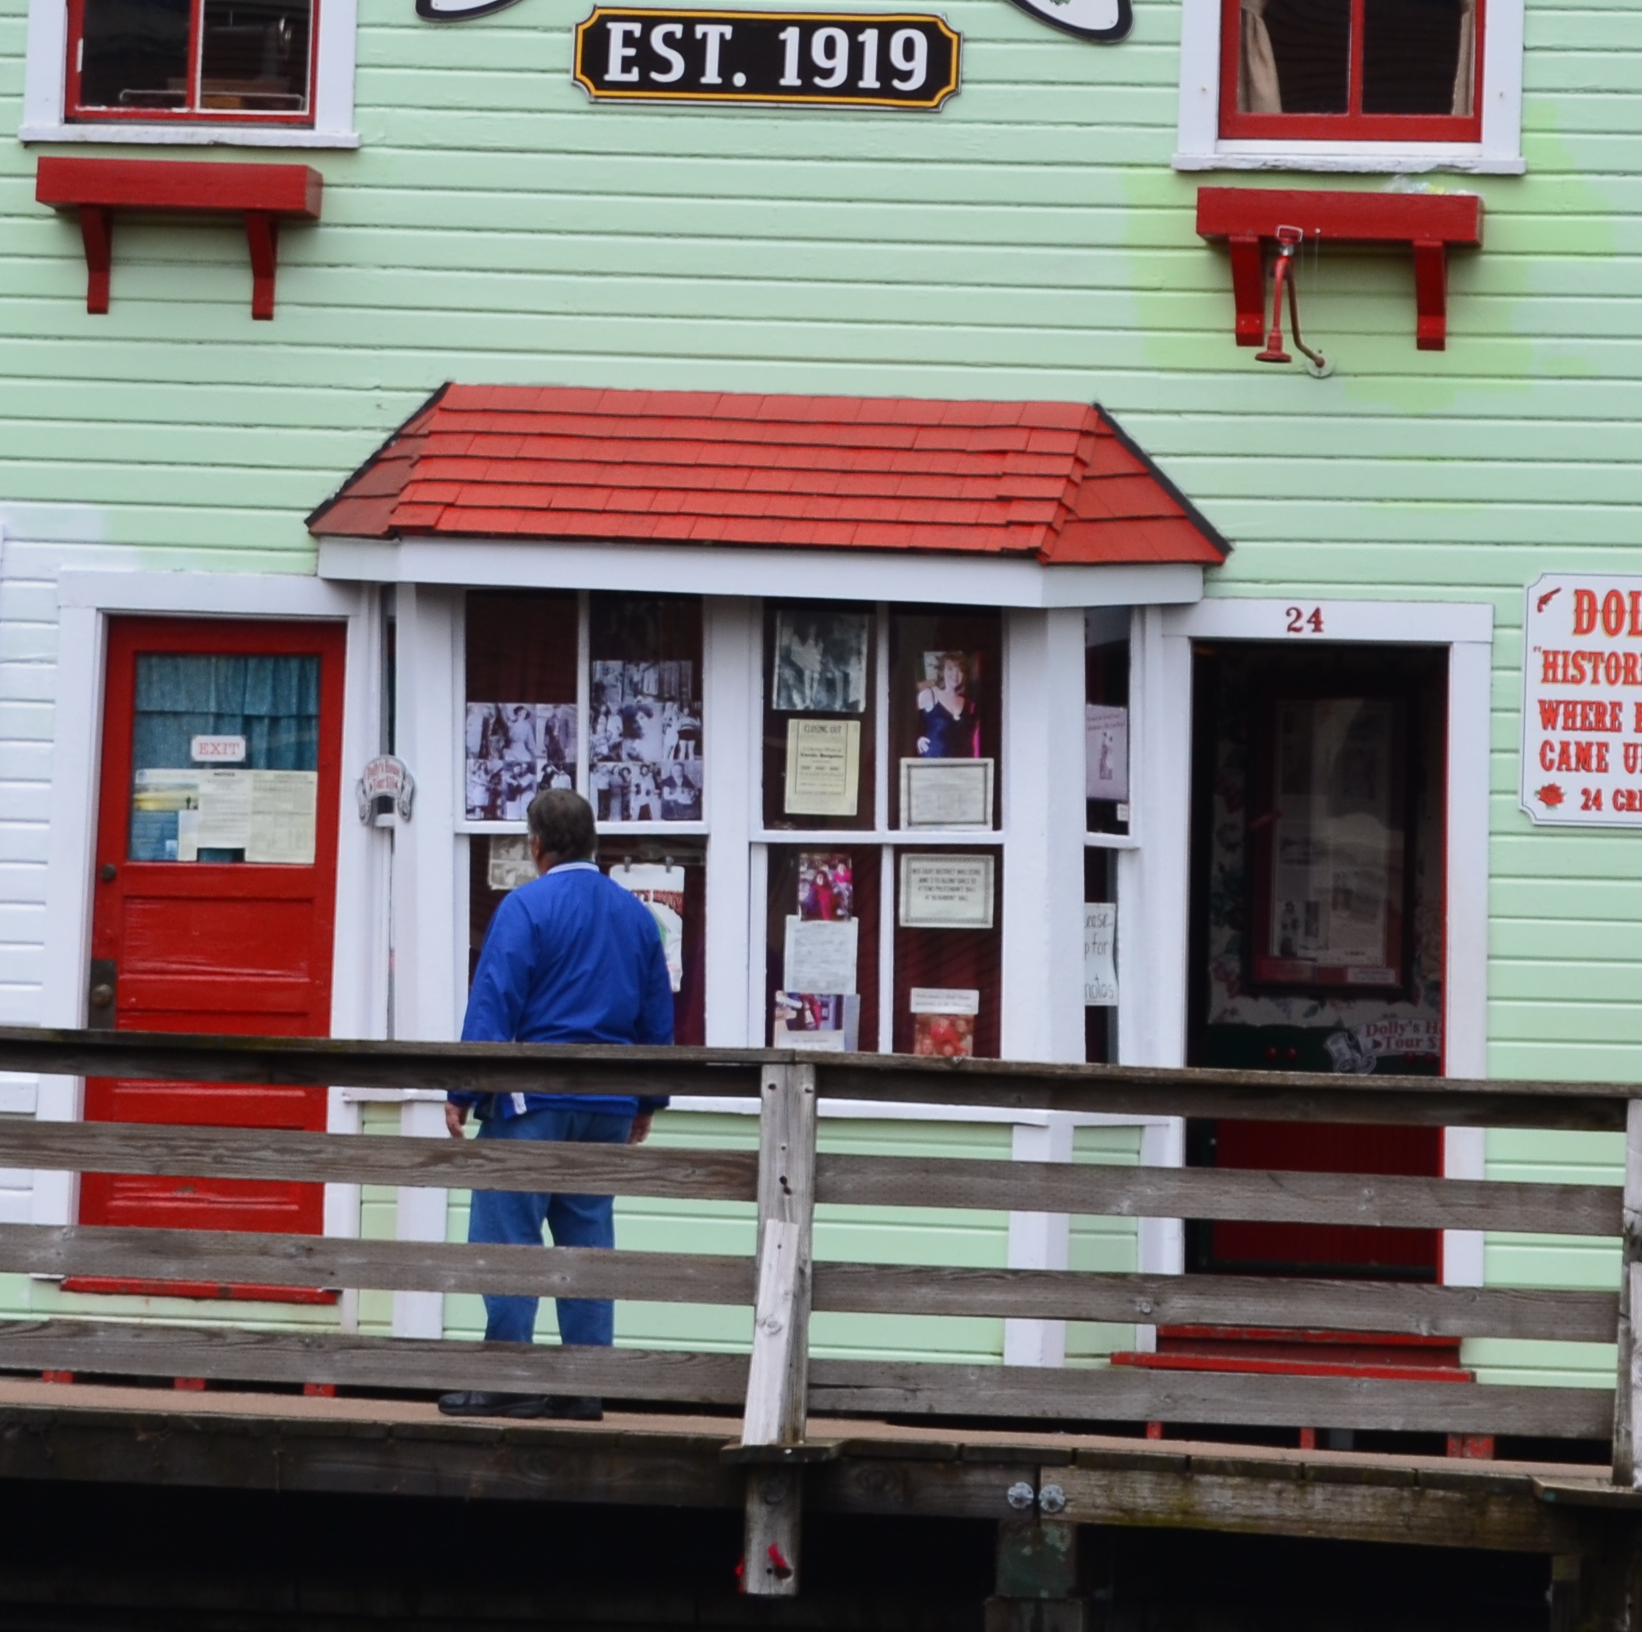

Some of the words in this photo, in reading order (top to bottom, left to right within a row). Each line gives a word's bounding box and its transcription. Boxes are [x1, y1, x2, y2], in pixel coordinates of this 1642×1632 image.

[603, 22, 747, 88] EST.
[778, 26, 929, 92] 1919
[1285, 606, 1325, 633] 24
[1537, 699, 1623, 733] WHERE
[198, 742, 240, 755] EXIT
[1539, 738, 1610, 773] CAME
[1580, 787, 1603, 811] 24
[1085, 913, 1108, 929] ease
[1093, 932, 1109, 956] for
[1365, 1020, 1421, 1038] Dolly's
[1385, 1035, 1423, 1049] Tour
